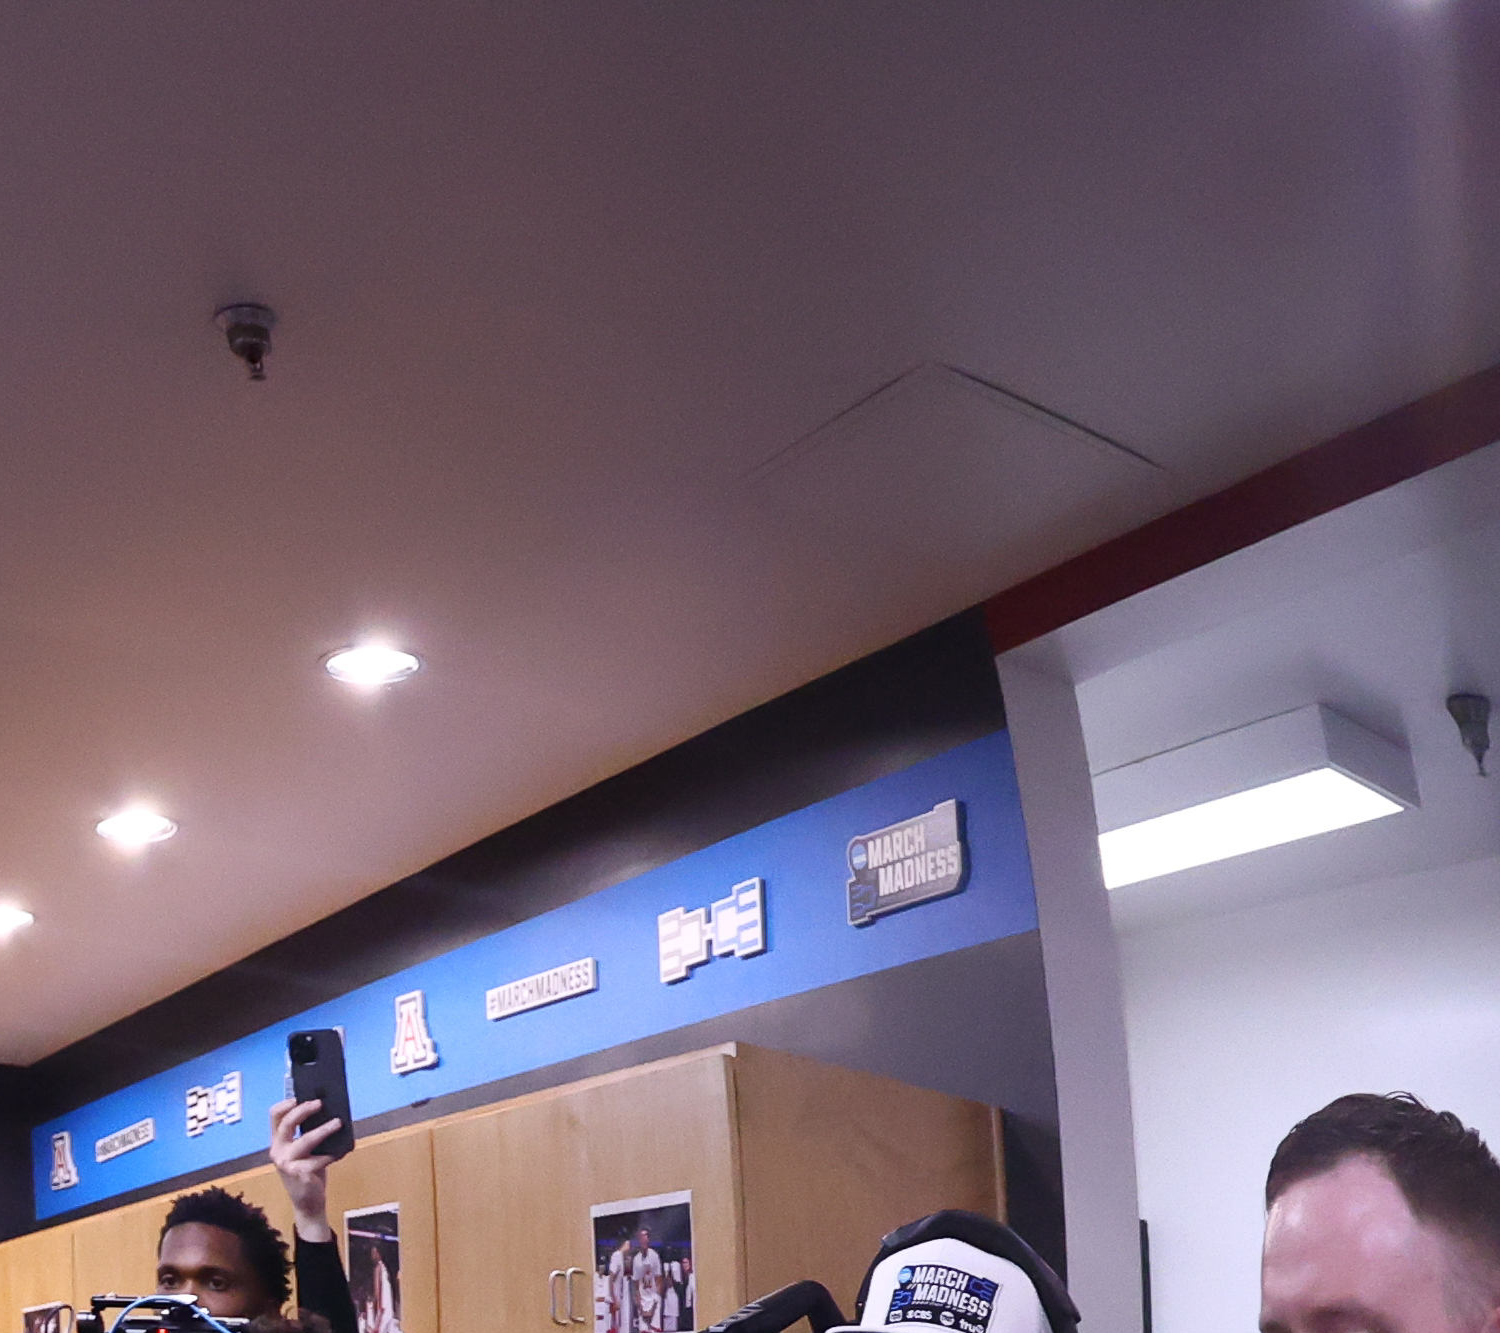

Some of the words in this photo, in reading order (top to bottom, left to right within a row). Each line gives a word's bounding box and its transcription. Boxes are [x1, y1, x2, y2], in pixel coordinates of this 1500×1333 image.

[866, 822, 927, 870] MARCH
[877, 843, 959, 897] MADNESS
[489, 961, 590, 1013] #MARCHMADNESS
[393, 995, 428, 1070] A
[911, 1266, 970, 1291] MARCH
[913, 1283, 991, 1318] MADNESS
